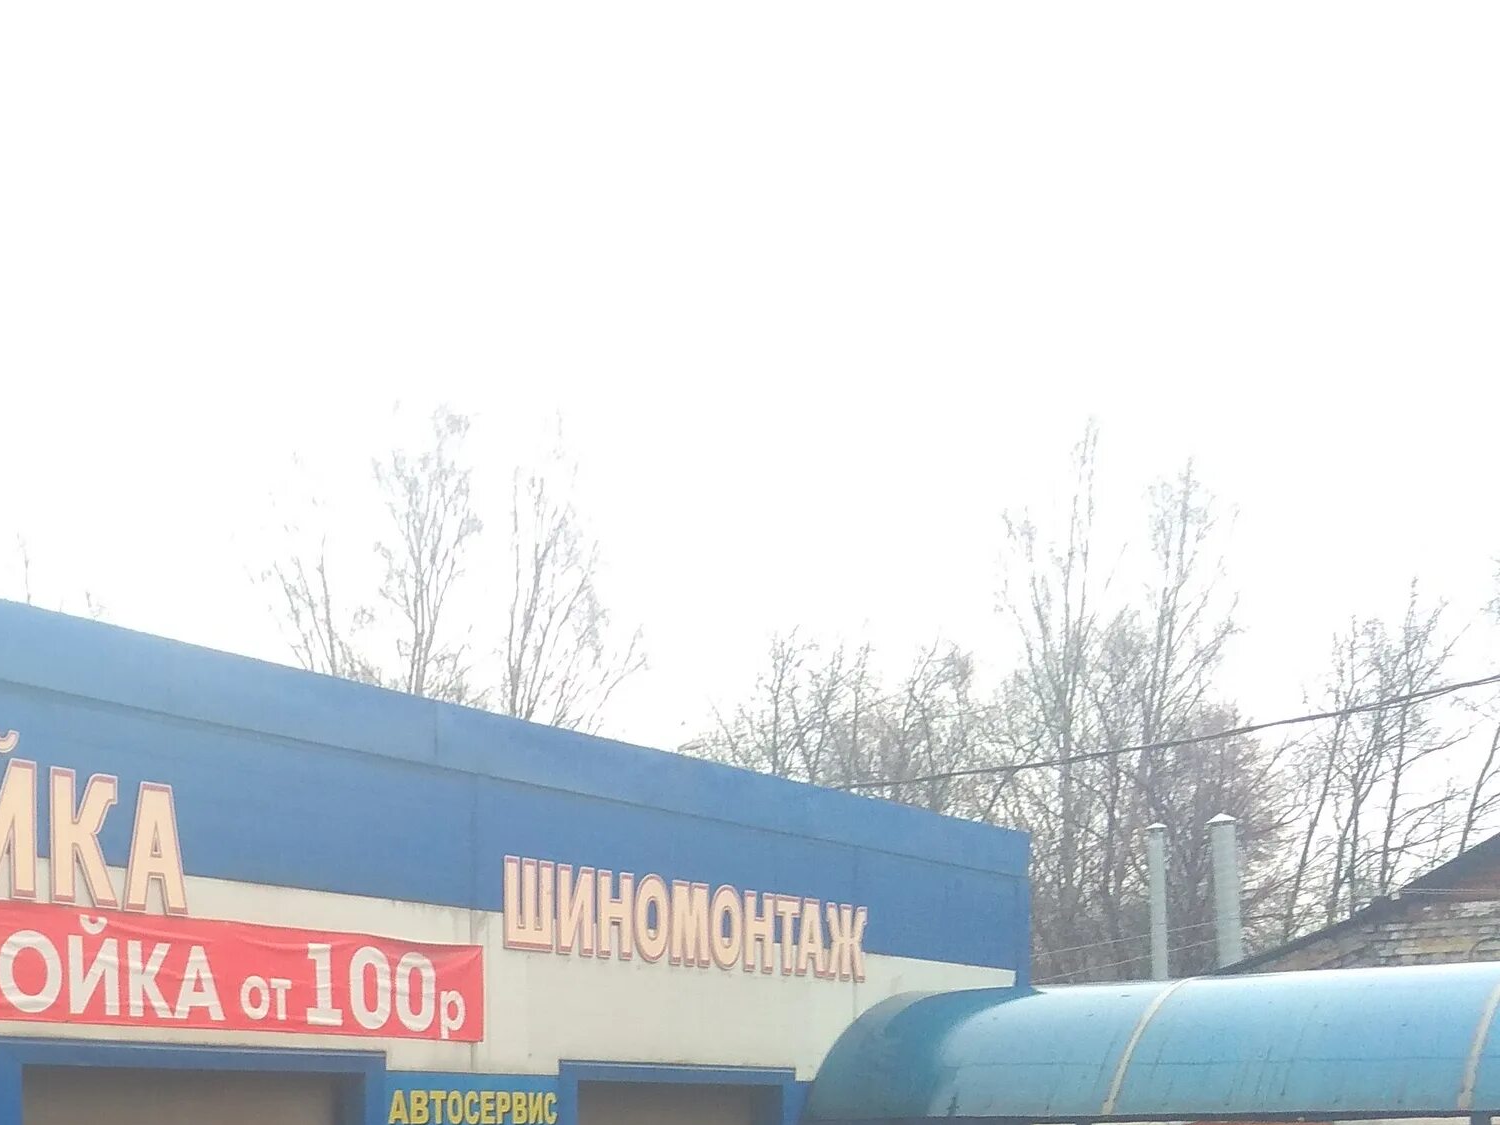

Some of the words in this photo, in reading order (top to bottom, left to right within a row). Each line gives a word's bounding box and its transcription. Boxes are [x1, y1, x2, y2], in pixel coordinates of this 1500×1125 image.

[503, 854, 869, 983] ШИНОМОНТАЖ
[306, 942, 466, 1039] 100р
[387, 1089, 558, 1125] АВТОСЕРВИС
